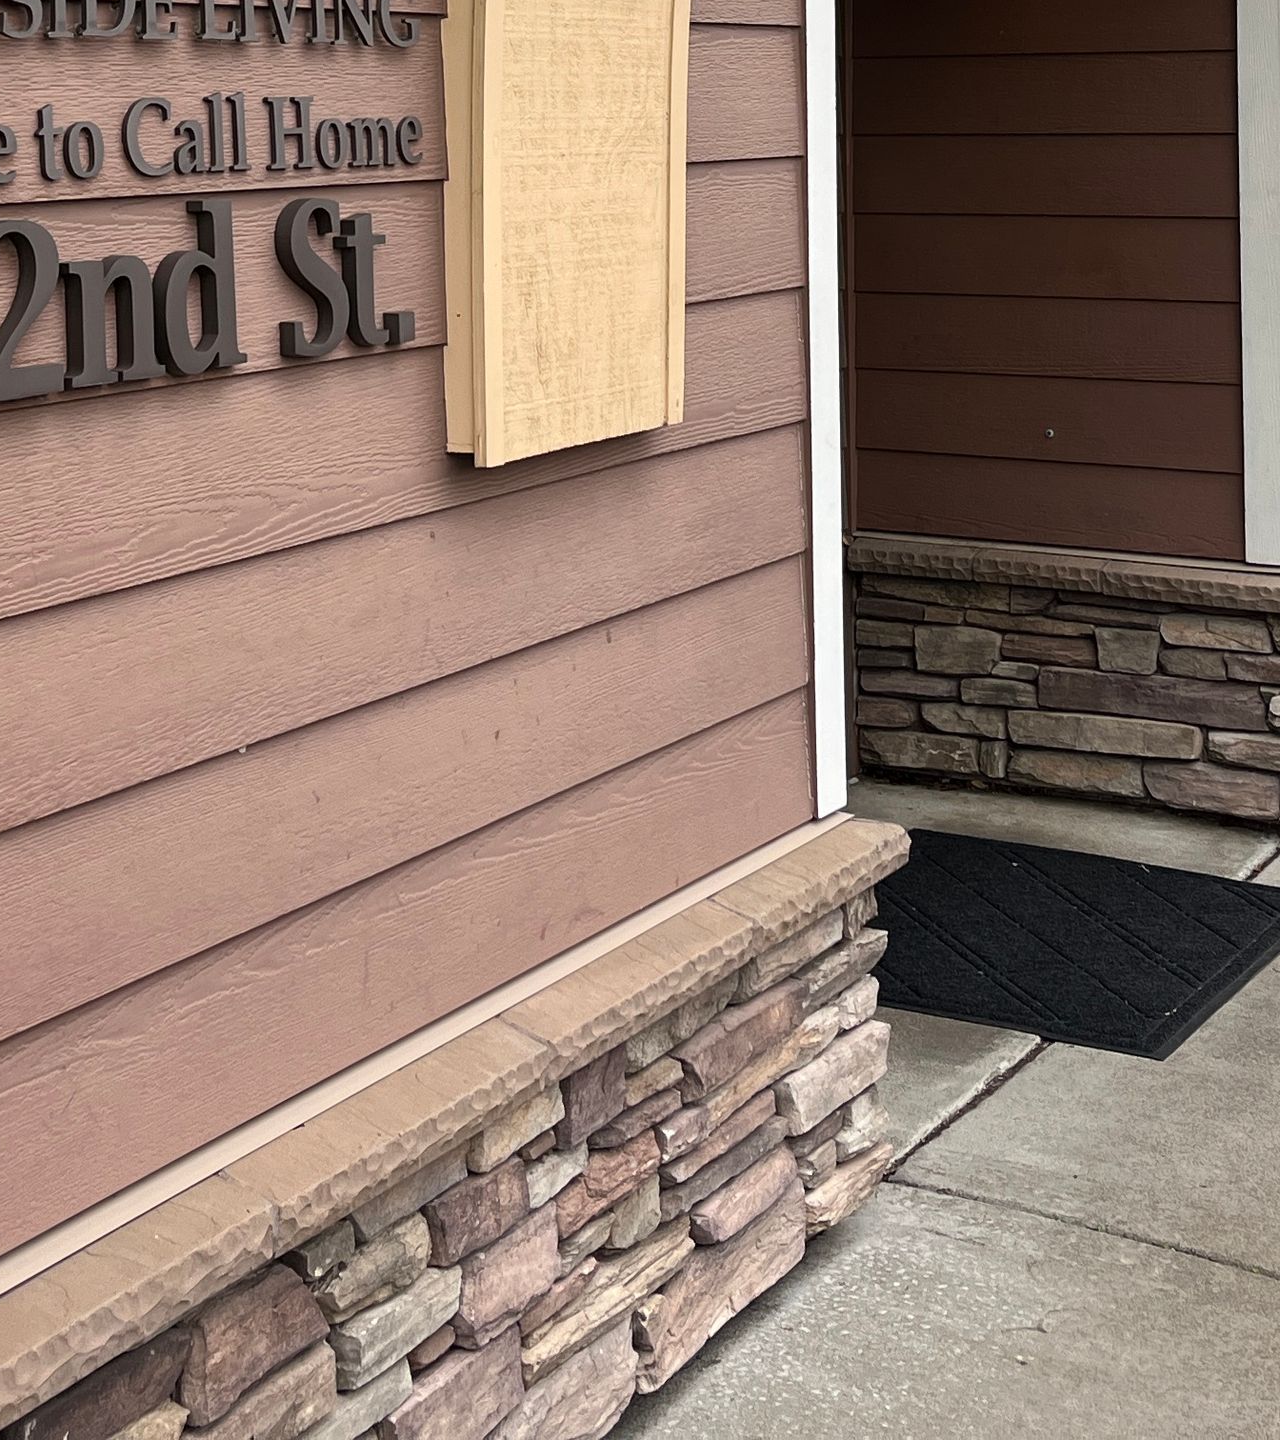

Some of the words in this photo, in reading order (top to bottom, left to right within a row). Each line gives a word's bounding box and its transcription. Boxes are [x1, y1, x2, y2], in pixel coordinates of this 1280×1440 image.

[37, 105, 104, 183] to
[120, 90, 247, 179] Call
[262, 94, 424, 174] Home
[274, 197, 416, 359] St.
